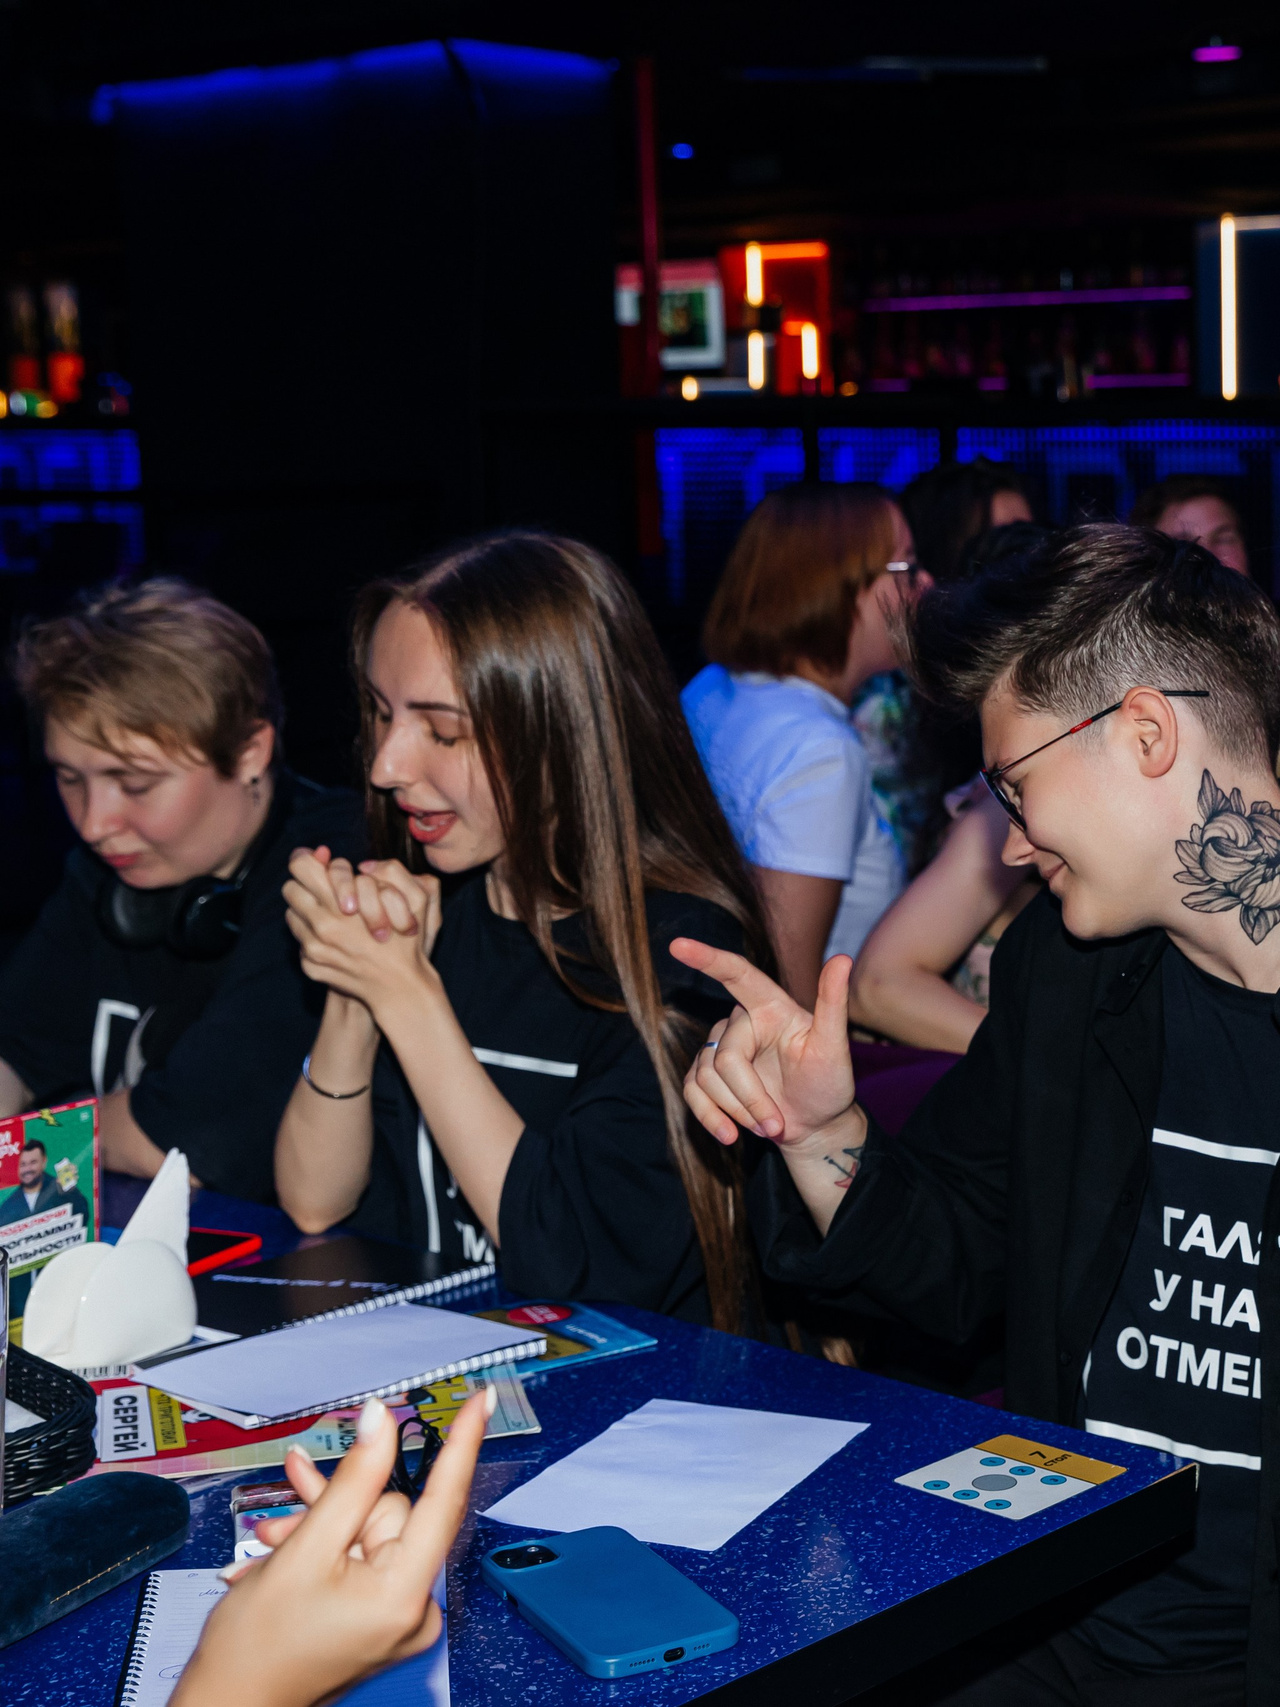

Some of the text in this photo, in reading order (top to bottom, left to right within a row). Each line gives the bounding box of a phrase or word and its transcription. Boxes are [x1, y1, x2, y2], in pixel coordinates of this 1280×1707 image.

[0, 1220, 77, 1250] ОГРАММУ
[9, 1233, 82, 1265] ЛЬНОСТИ
[1149, 1268, 1261, 1333] У НА
[1116, 1326, 1263, 1399] ОТМЕ
[113, 1395, 147, 1453] СЕРГЕЙ
[1028, 1450, 1046, 1459] 7
